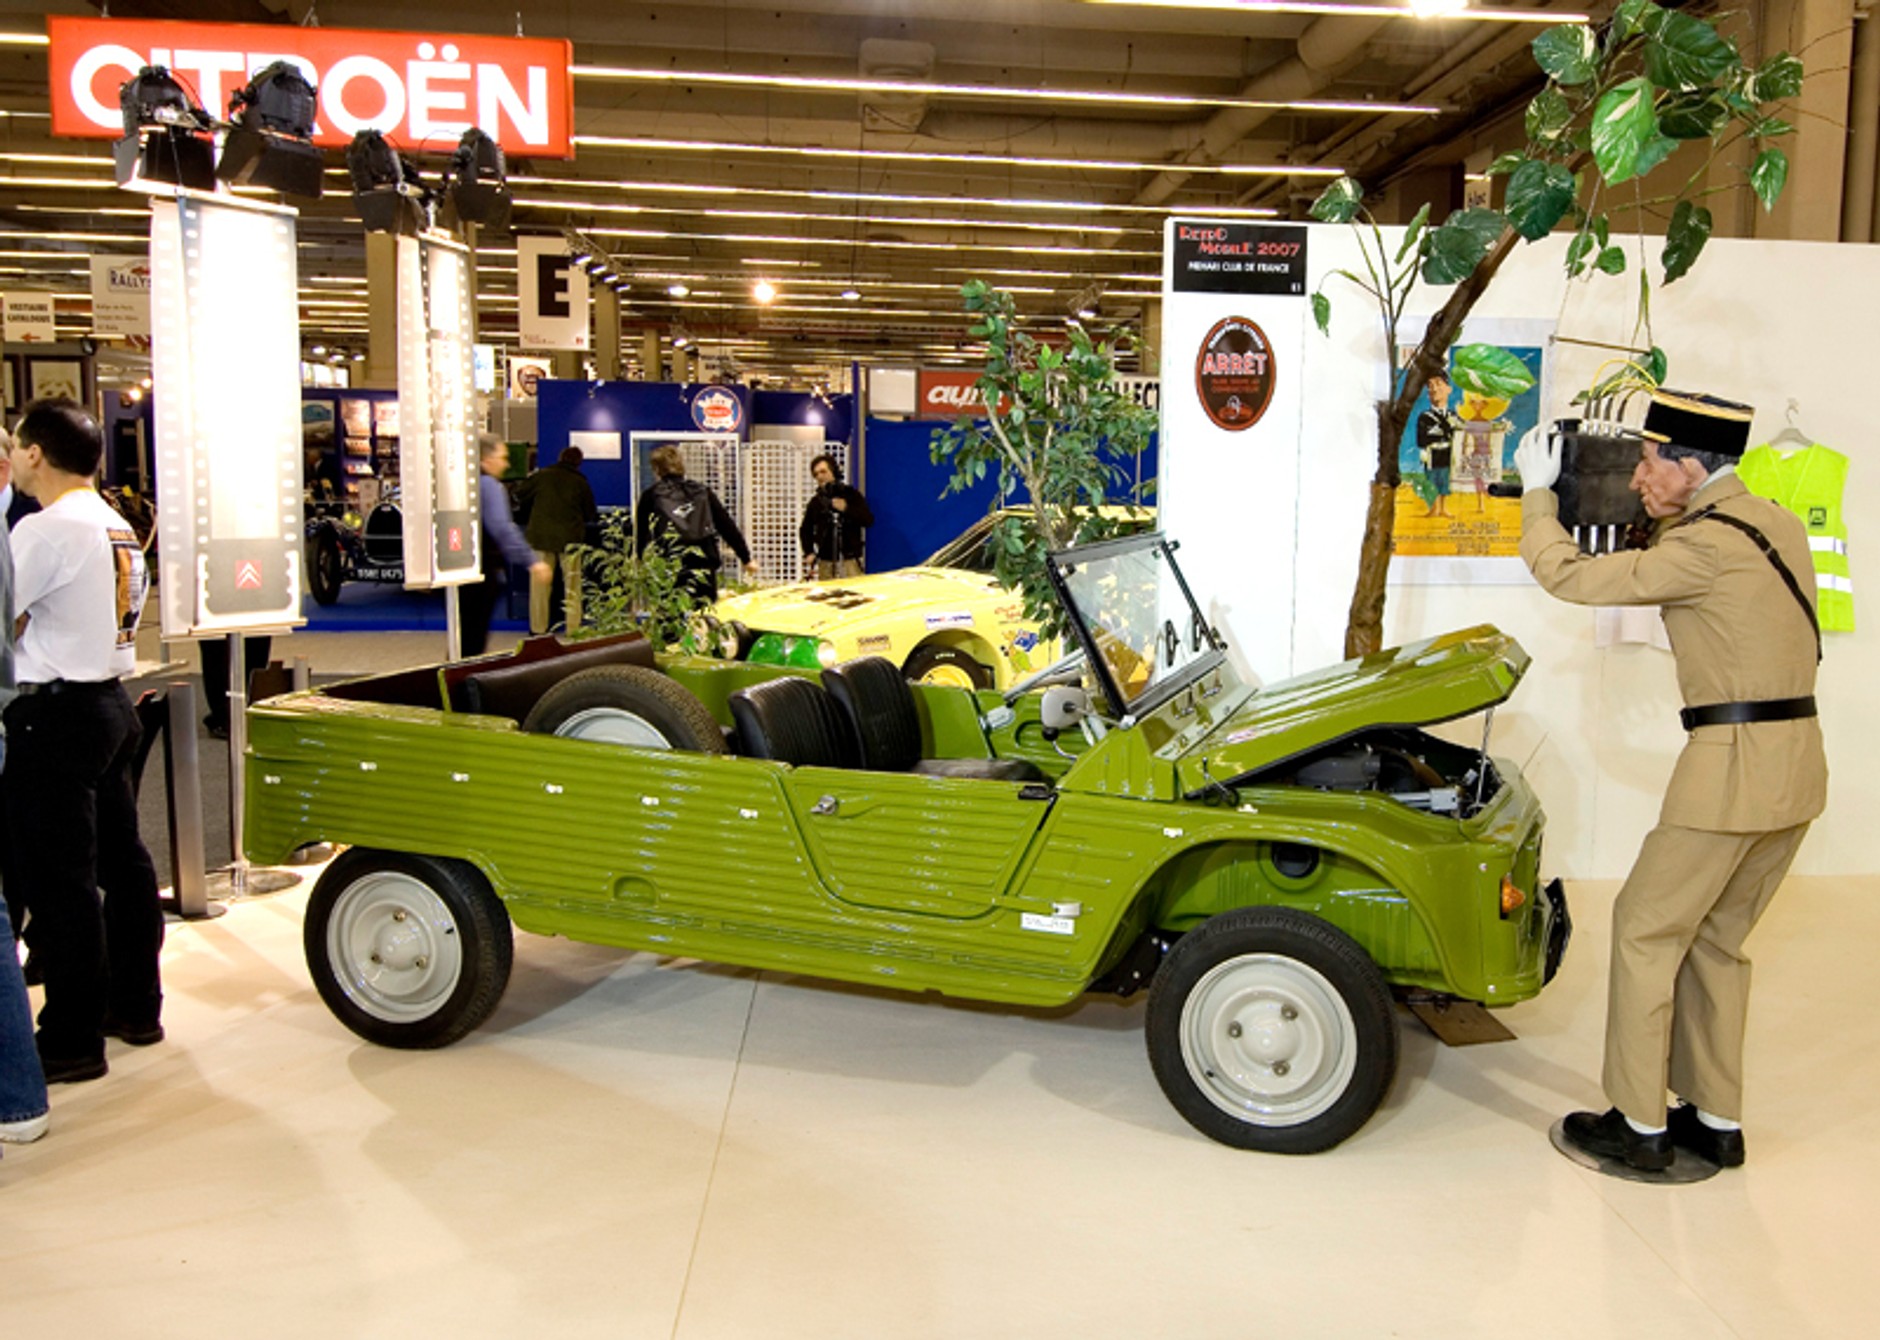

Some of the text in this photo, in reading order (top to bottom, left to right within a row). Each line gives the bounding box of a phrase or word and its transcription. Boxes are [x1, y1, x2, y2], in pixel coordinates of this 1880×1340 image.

[70, 42, 548, 146] CTOËN
[1257, 242, 1301, 257] 2007
[1222, 261, 1243, 272] CLUB
[1245, 262, 1255, 272] DE
[1257, 262, 1290, 274] FRANCE
[537, 253, 572, 318] E
[1202, 350, 1268, 375] ARRÊT
